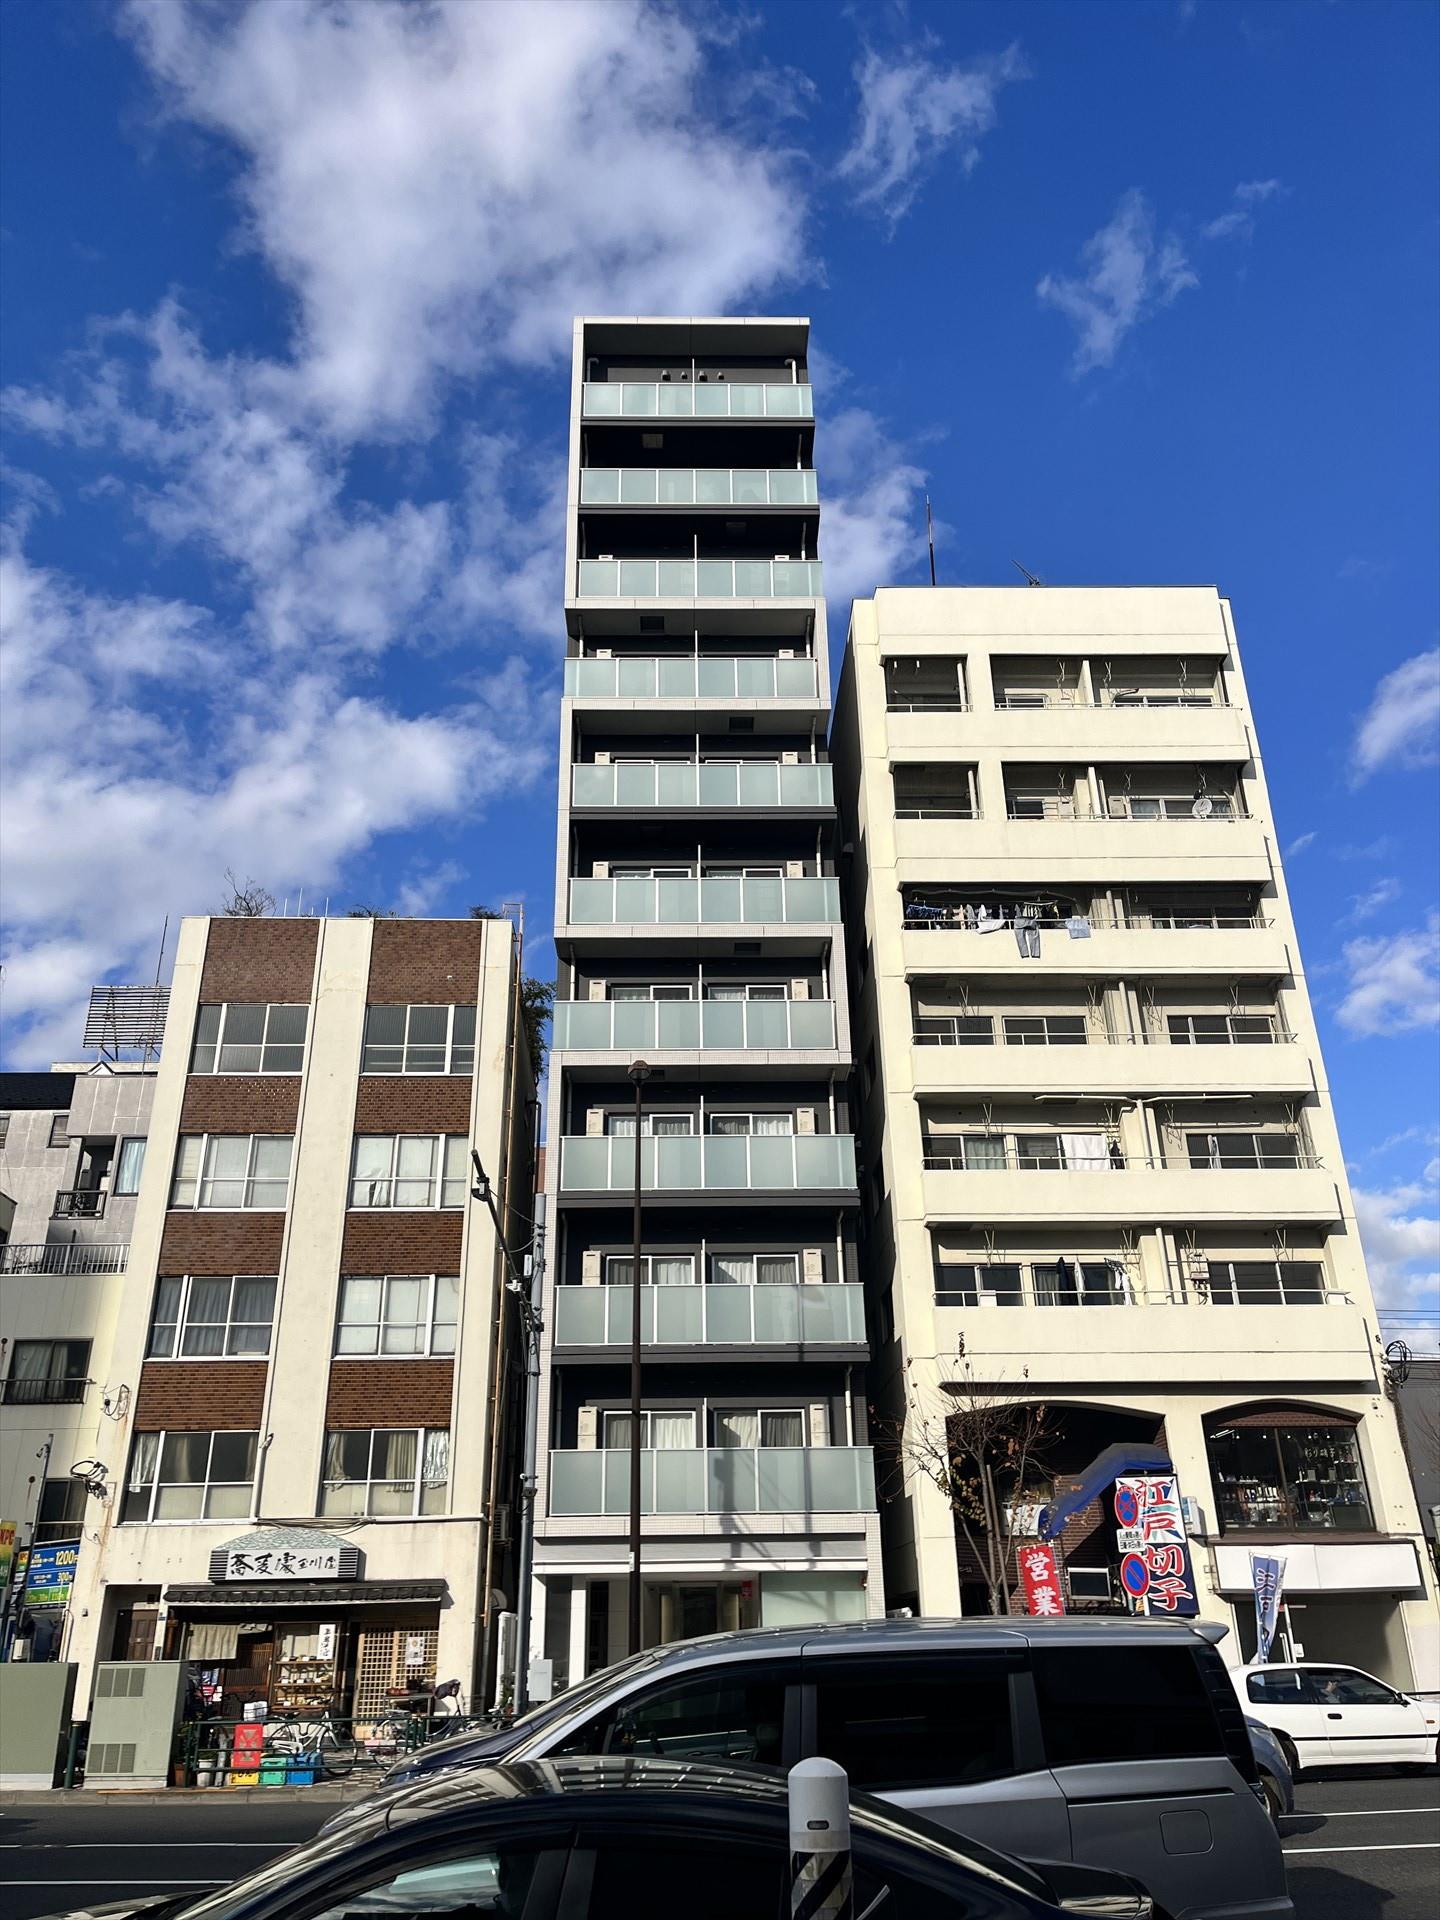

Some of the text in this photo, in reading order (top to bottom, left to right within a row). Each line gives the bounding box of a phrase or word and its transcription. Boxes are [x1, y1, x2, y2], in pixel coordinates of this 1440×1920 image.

[1025, 1551, 1061, 1616] 営業
[1134, 1479, 1193, 1612] 江戸切子
